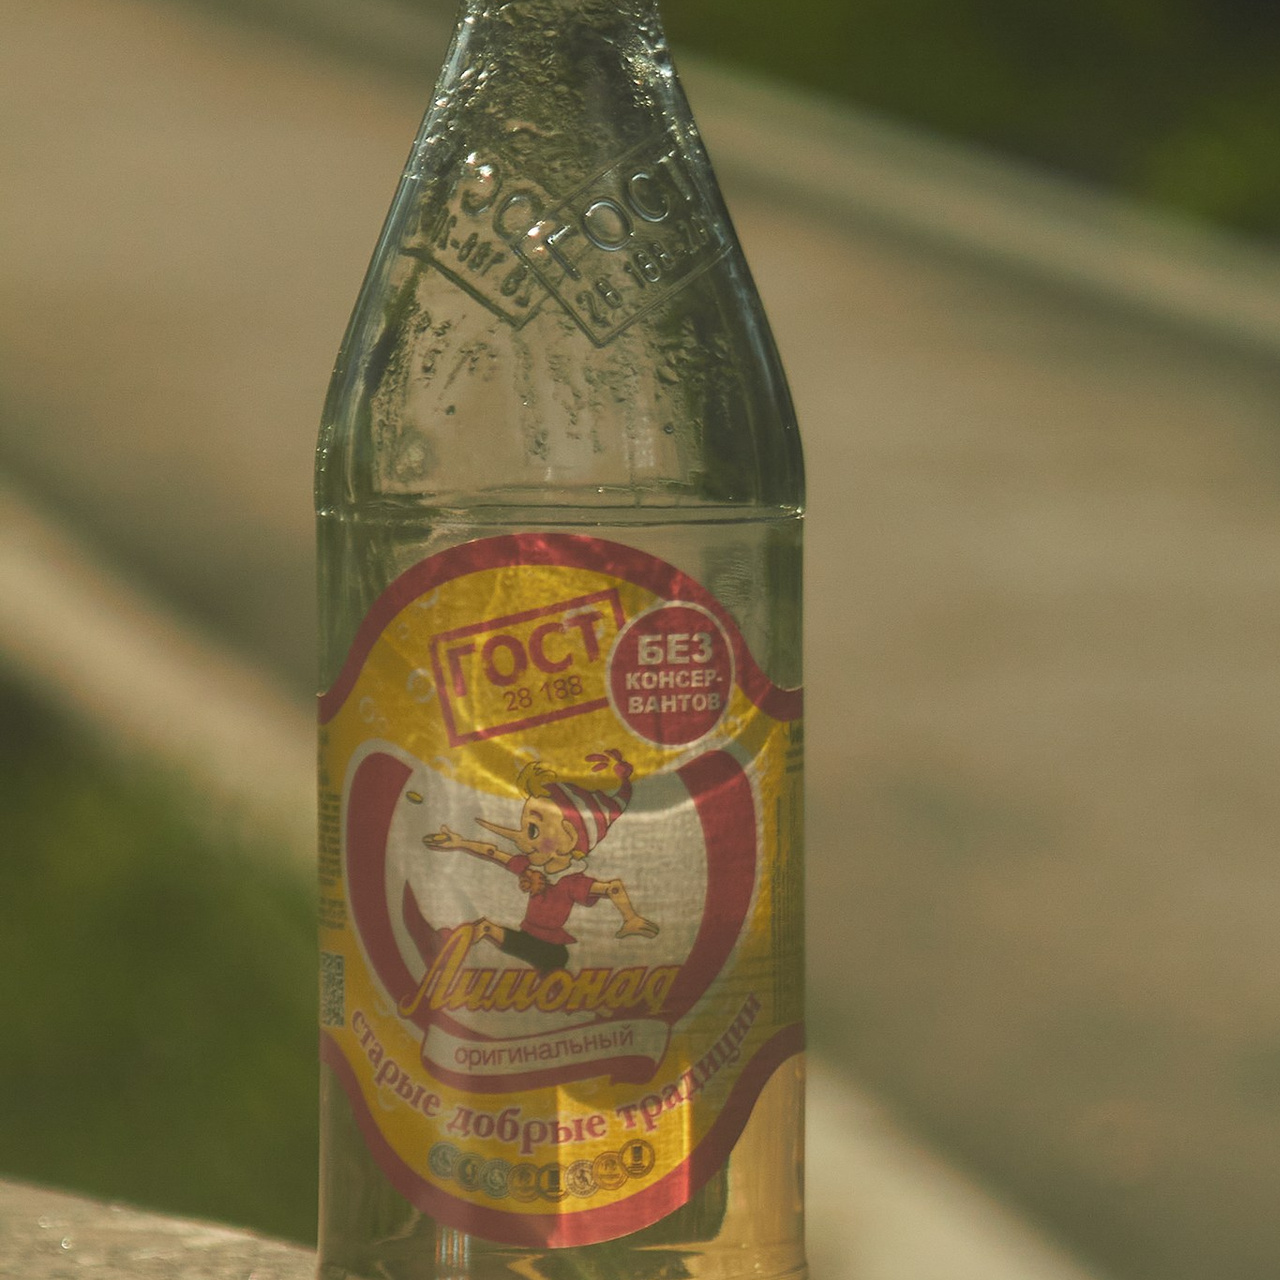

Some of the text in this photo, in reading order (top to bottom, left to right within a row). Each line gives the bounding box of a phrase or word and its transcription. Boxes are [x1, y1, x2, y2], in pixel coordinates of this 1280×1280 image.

[546, 148, 692, 281] ГОСТ
[446, 610, 605, 698] ГОСТ
[636, 633, 714, 666] БЕЗ
[503, 674, 583, 712] 28 188
[625, 670, 724, 692] КОНСЕР-
[627, 693, 722, 715] ВАНТОВ
[400, 921, 684, 1023] Лимонад
[453, 1022, 635, 1071] оригинальный
[351, 992, 762, 1155] старые добрые традиции
